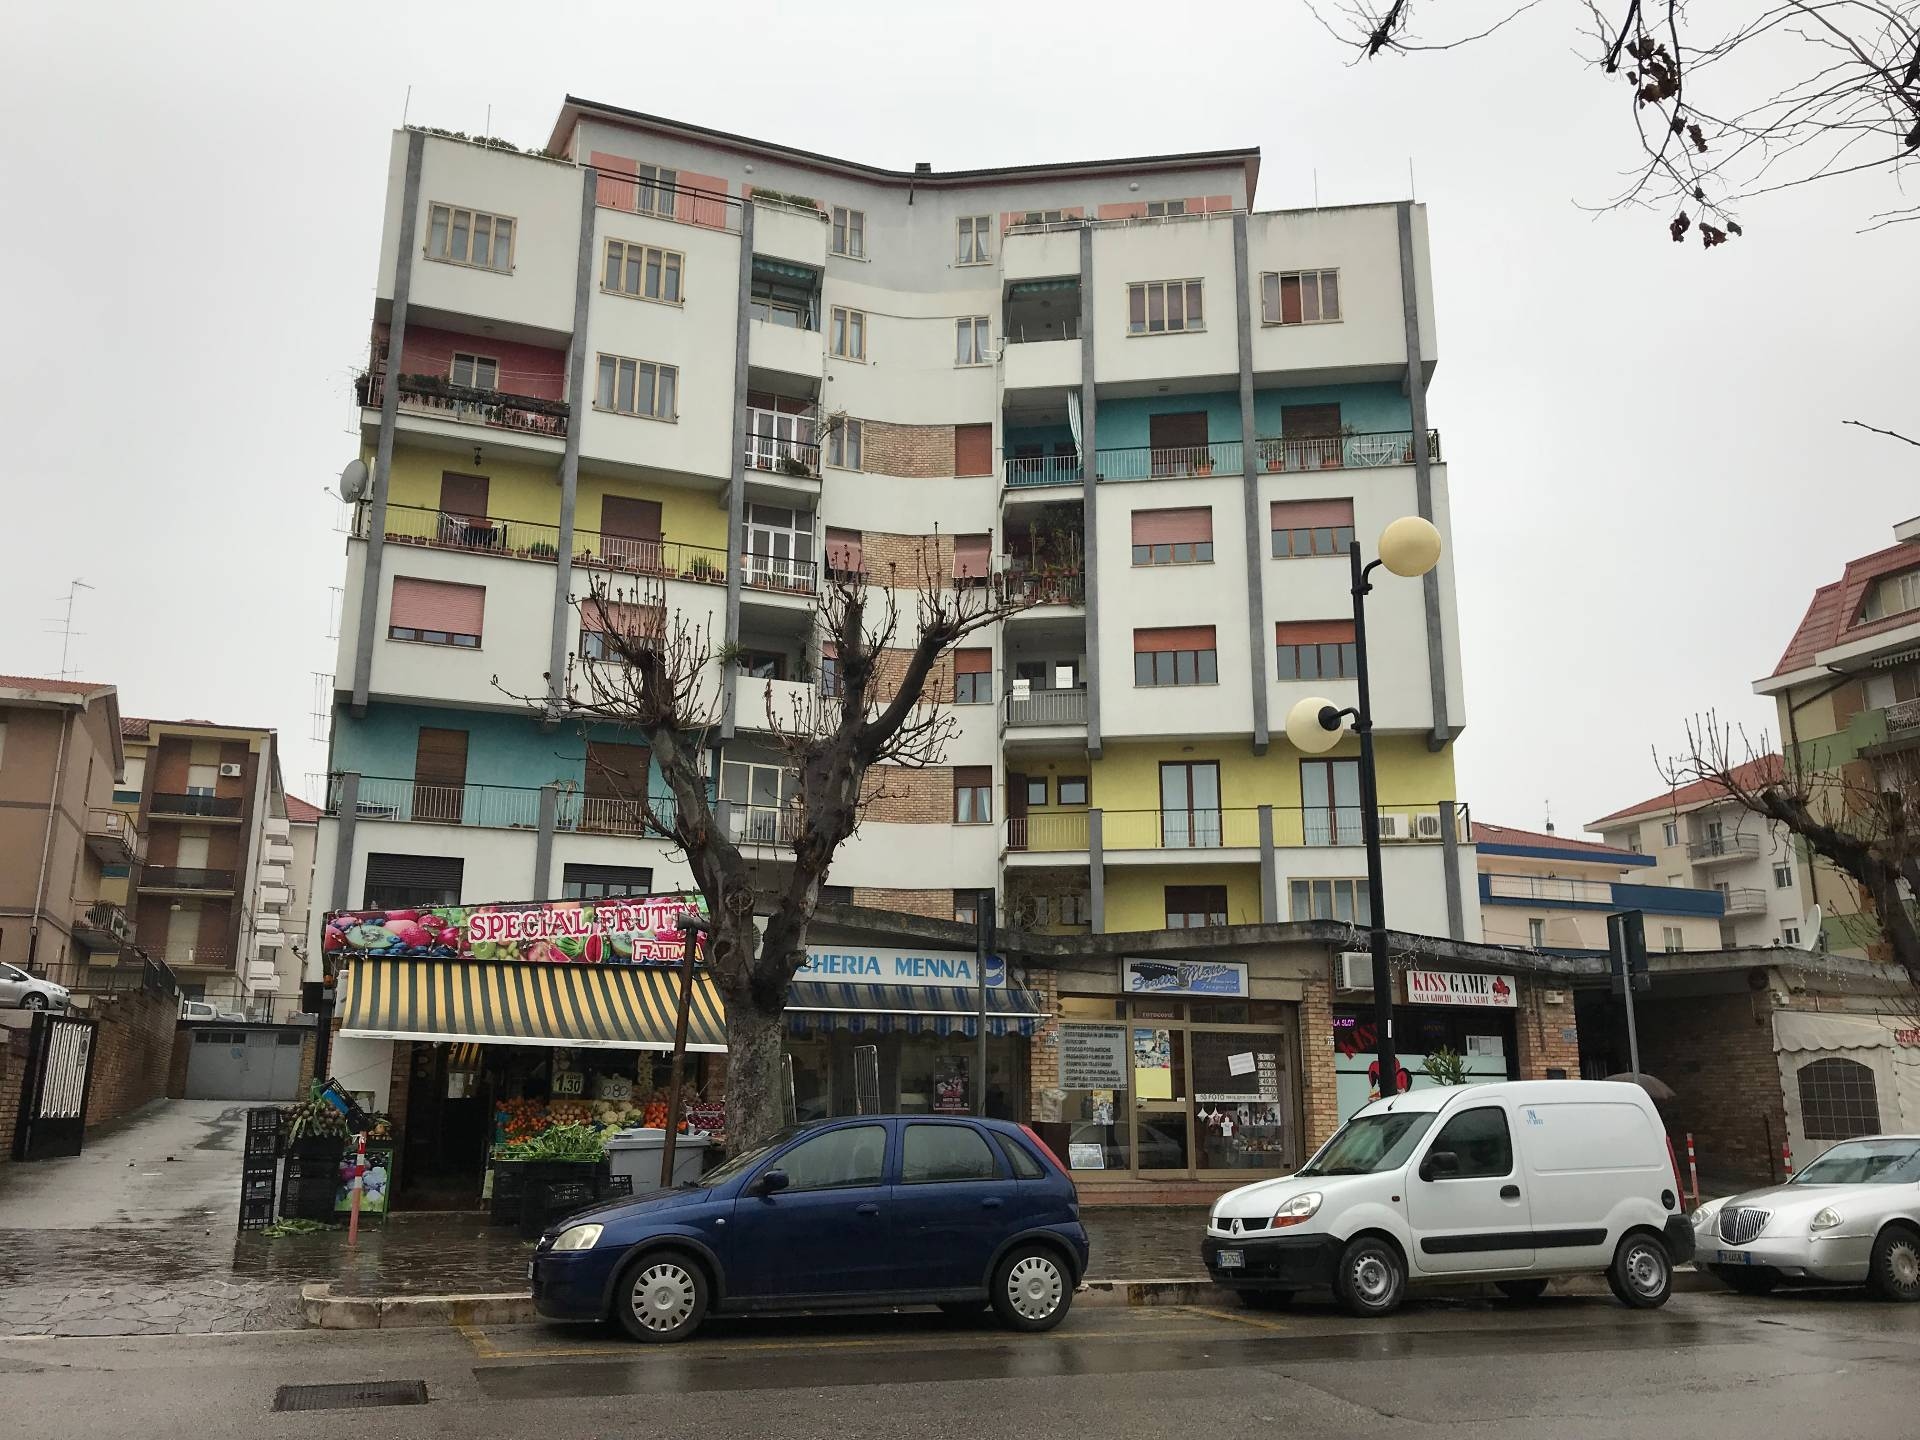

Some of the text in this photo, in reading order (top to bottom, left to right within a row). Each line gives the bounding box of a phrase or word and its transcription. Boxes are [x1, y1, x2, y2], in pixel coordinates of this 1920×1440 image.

[468, 903, 698, 941] SPECIAL FRUTT
[896, 957, 972, 979] MENNA
[1413, 972, 1489, 994] KISS GAME
[1342, 1019, 1355, 1027] SLOT
